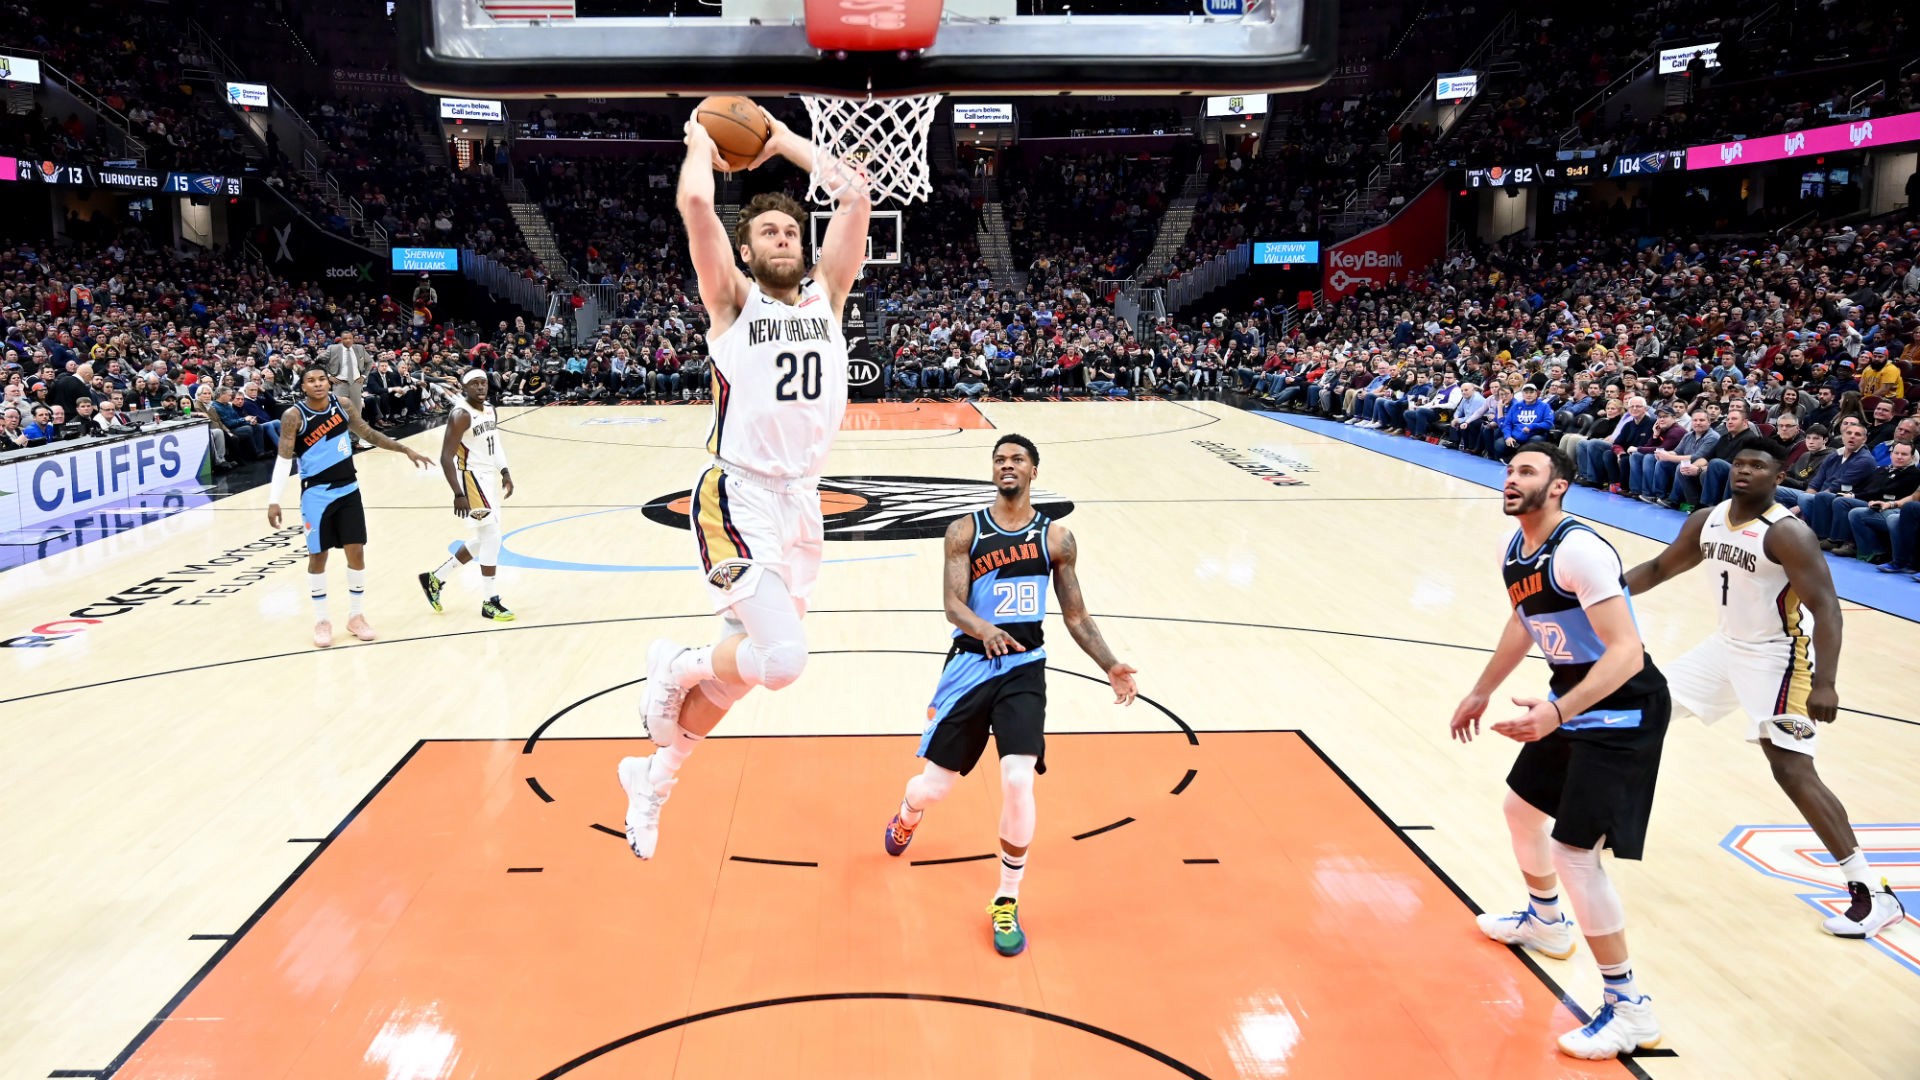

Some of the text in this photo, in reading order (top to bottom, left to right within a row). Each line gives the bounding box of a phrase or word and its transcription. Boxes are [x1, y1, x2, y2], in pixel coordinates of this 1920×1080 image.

[1672, 59, 1687, 68] Call
[1784, 132, 1805, 156] lyft
[1849, 121, 1873, 147] lyft
[1674, 156, 1681, 169] 0
[1720, 142, 1743, 165] lyft
[20, 168, 31, 180] 41
[68, 167, 82, 184] 13
[1514, 168, 1533, 183] 92
[1566, 165, 1589, 177] 9:41
[1619, 157, 1640, 174] 104
[99, 172, 158, 187] TURNOVERS
[173, 175, 188, 192] 15
[228, 184, 240, 195] 55
[404, 248, 445, 259] SHERWIN
[1264, 242, 1306, 253] SHERWIN
[403, 259, 447, 270] WILLIAMS
[1263, 253, 1306, 264] WILLIAMS
[1329, 250, 1403, 271] KeyBank
[749, 317, 782, 347] NEW
[775, 351, 823, 401] 20
[847, 365, 873, 380] KIA
[303, 413, 343, 447] CLEVELAND
[337, 435, 350, 457] 4
[486, 435, 495, 456] 11
[32, 433, 182, 512] CLIFFS
[971, 543, 1039, 580] LEVELAND
[1717, 542, 1757, 573] ORLEANS
[1720, 570, 1729, 606] 1
[993, 581, 1039, 617] 28
[0, 576, 197, 648] ROCKET
[1529, 619, 1574, 661] 22
